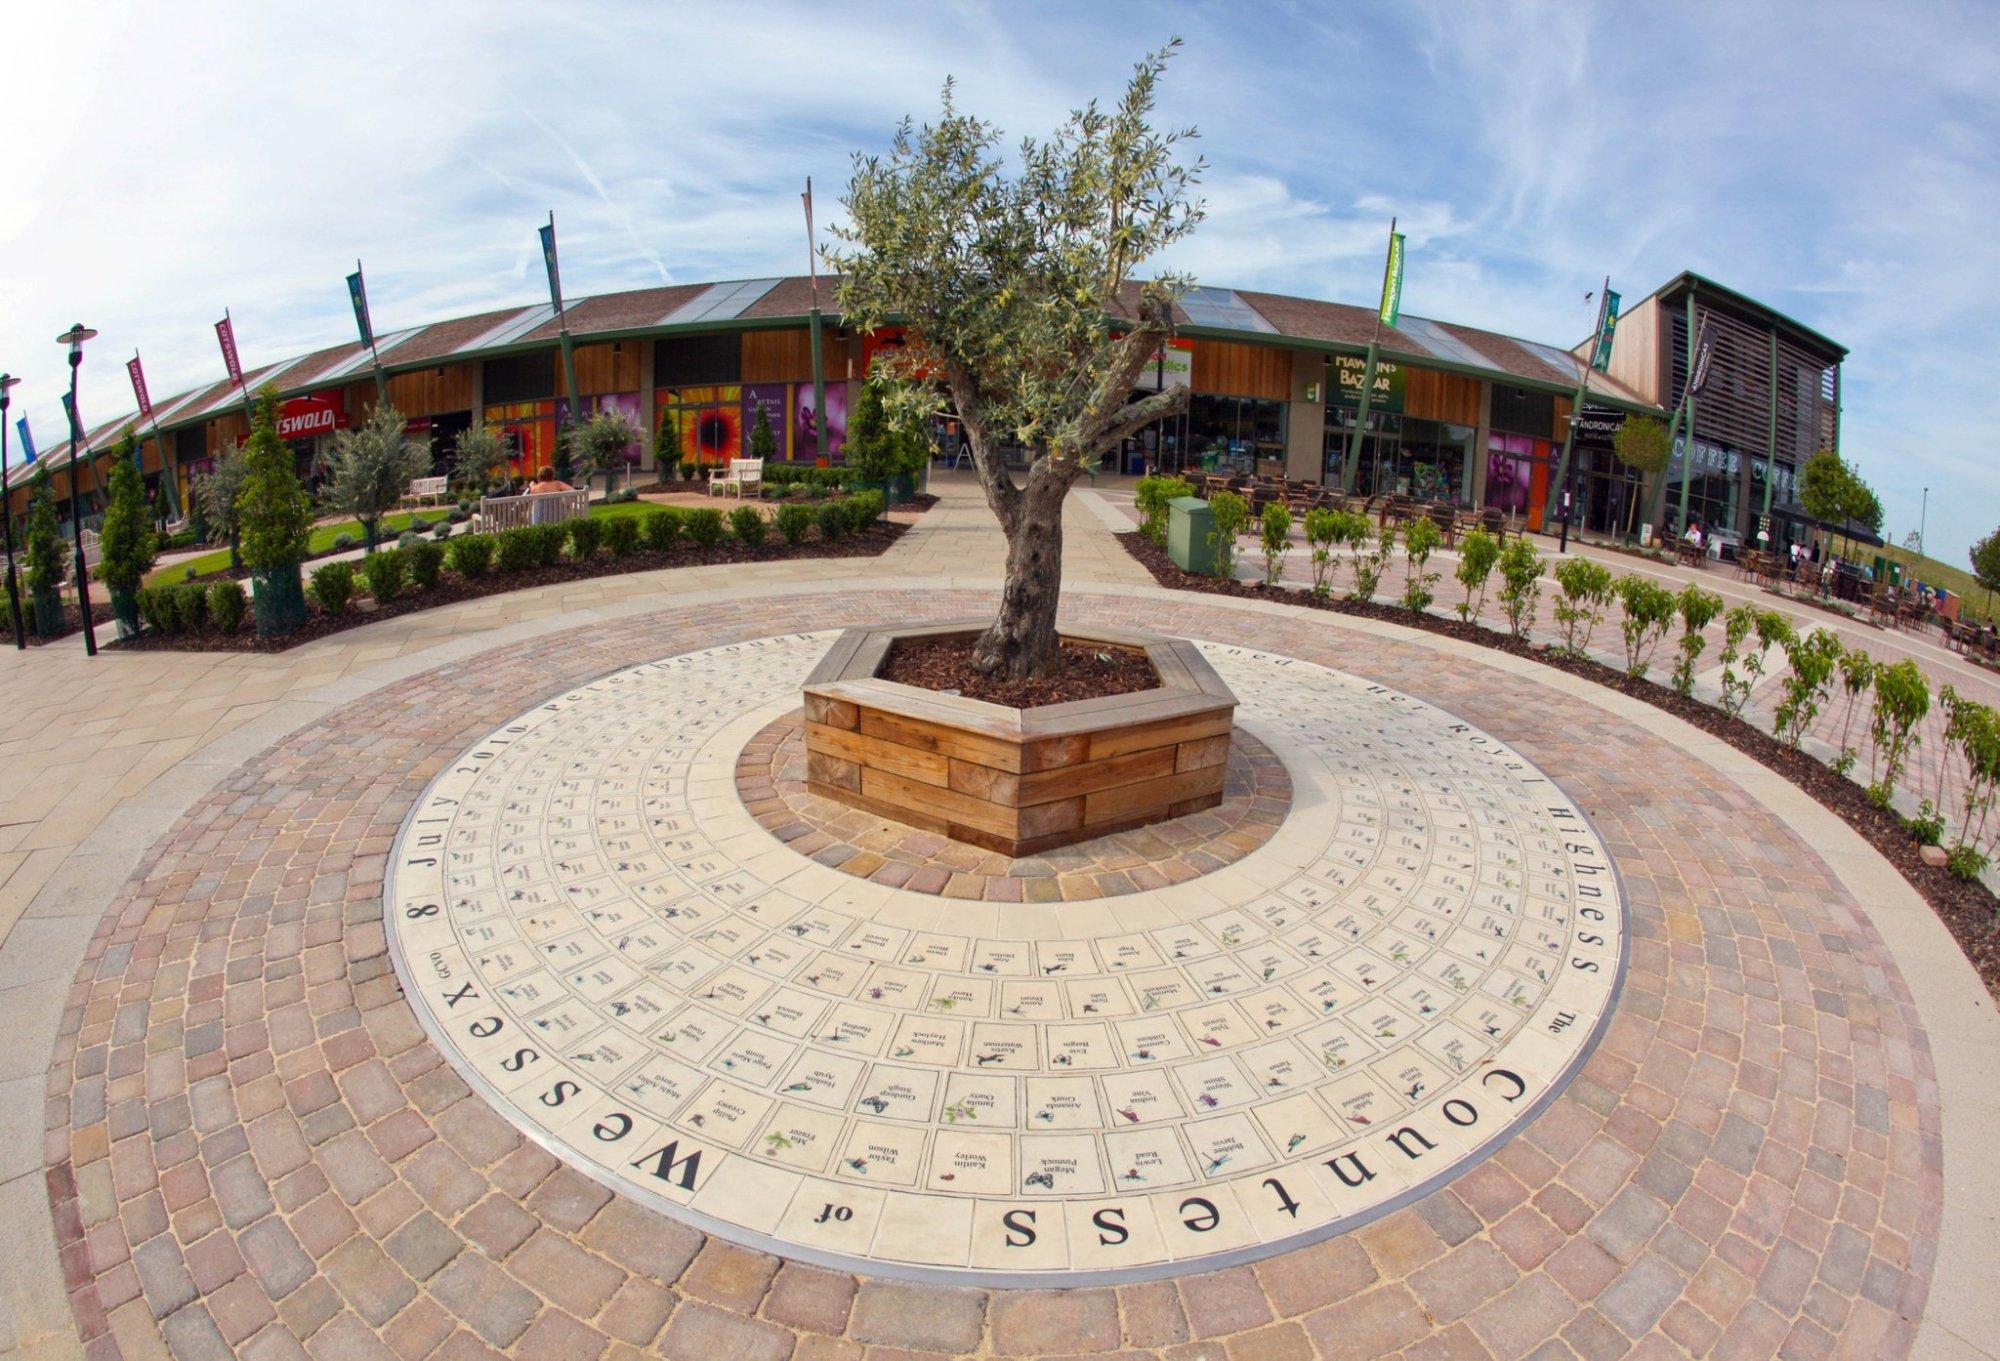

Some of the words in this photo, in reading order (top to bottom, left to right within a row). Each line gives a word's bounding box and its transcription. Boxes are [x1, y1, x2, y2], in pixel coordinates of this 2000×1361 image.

[1340, 369, 1391, 391] BAZAR
[276, 409, 334, 434] SWOLD
[1203, 643, 1293, 667] ened
[544, 632, 814, 713] Peterborough
[1366, 685, 1430, 711] Her
[1448, 723, 1546, 784] Royal
[407, 796, 459, 868] July
[1547, 806, 1608, 976] Highness
[429, 950, 453, 979] GCVO
[1549, 1012, 1578, 1035] The
[908, 1037, 944, 1048] Matthew
[910, 1031, 946, 1041] Haylock
[982, 1040, 1022, 1048] Waterman
[442, 982, 705, 1194] Wessex
[1131, 1089, 1152, 1097] Vine
[1128, 1095, 1158, 1104] Joshua
[866, 1143, 899, 1156] Wilson
[1210, 1136, 1237, 1147] Jarvis
[866, 1151, 897, 1164] Taylor
[953, 1151, 987, 1162] Worley
[1003, 1070, 1528, 1250] Countess
[1133, 1150, 1158, 1160] Read
[1134, 1157, 1162, 1167] Lewis
[953, 1160, 986, 1169] Kaitlin
[1042, 1164, 1075, 1173] Megan
[813, 1204, 857, 1226] of
